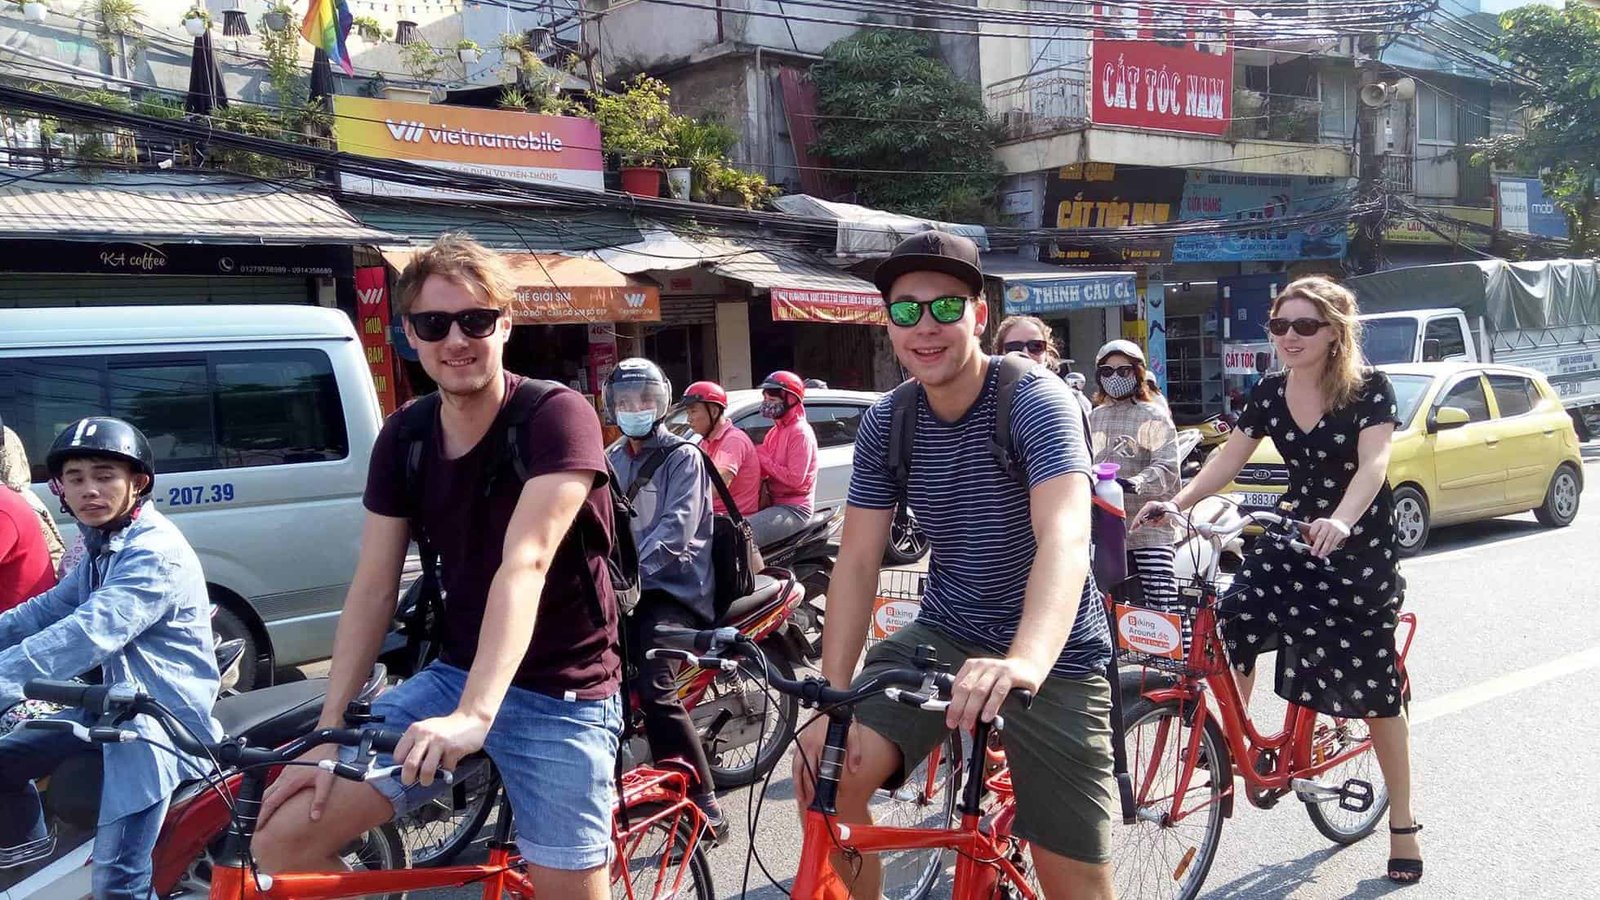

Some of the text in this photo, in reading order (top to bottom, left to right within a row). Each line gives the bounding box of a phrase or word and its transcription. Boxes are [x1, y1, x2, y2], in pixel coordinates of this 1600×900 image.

[1185, 74, 1225, 120] NAM
[427, 123, 563, 152] vietnamobile
[129, 251, 166, 270] coffee
[169, 483, 234, 506] 207.39
[885, 606, 913, 619] Biking
[1128, 615, 1156, 629] Biking
[1129, 627, 1157, 638] Around
